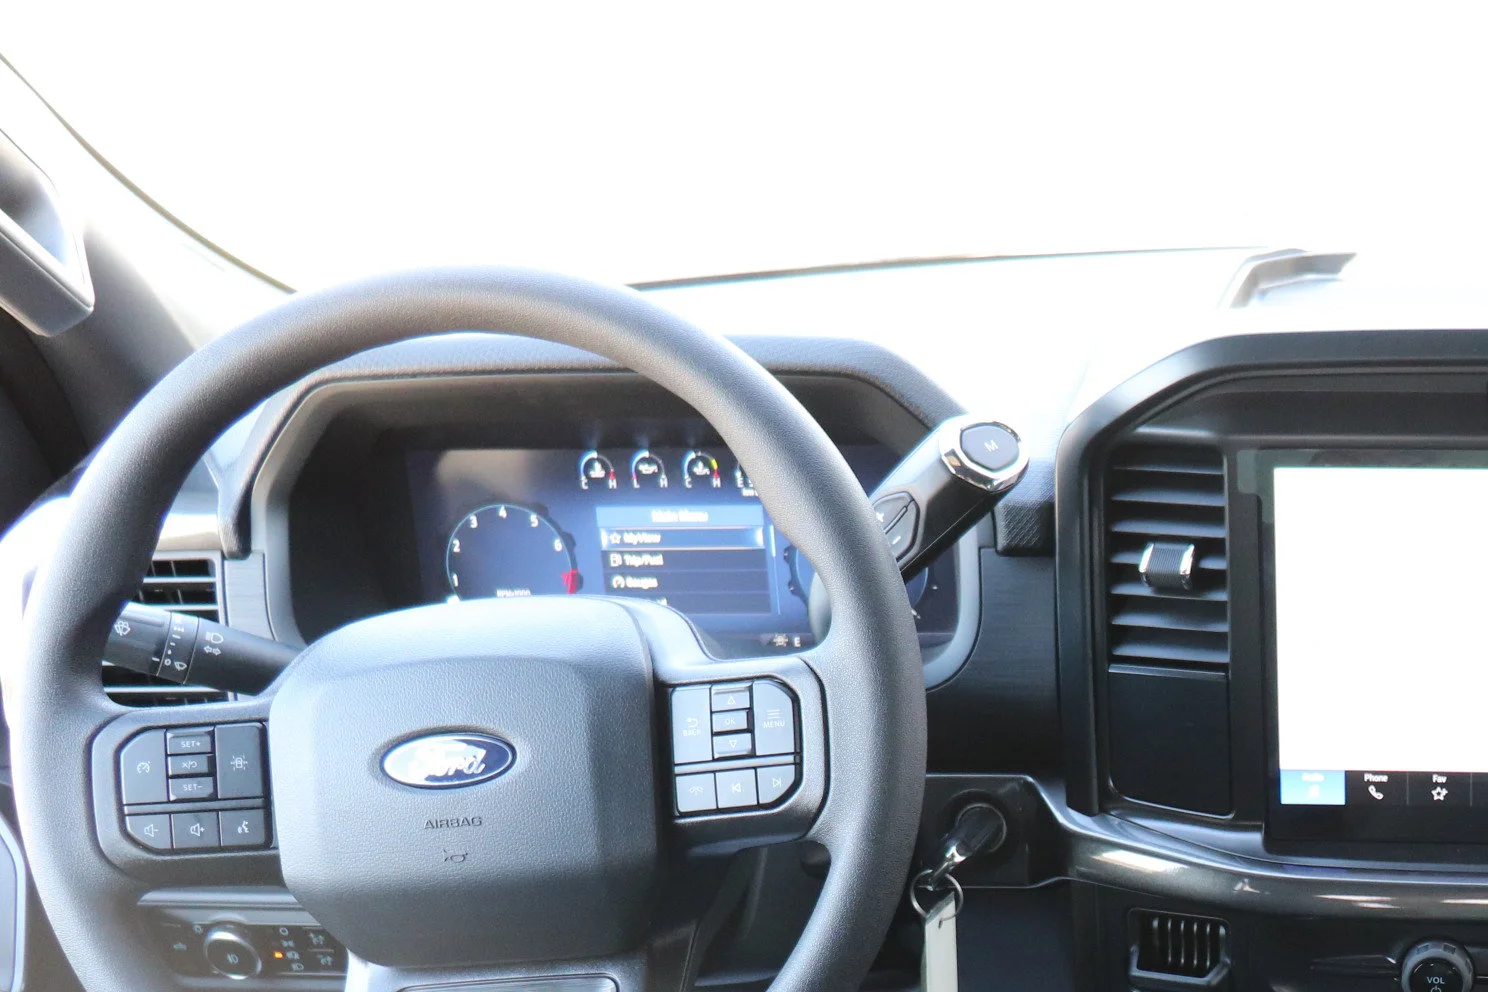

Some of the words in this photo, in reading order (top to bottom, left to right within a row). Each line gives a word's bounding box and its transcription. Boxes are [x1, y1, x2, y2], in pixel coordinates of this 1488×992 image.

[984, 440, 998, 452] M
[608, 478, 617, 489] H
[712, 477, 721, 488] H
[499, 505, 507, 518] 4
[470, 515, 478, 528] 3
[530, 514, 538, 527] 5
[452, 539, 460, 552] 2
[554, 538, 562, 551] 6
[453, 573, 459, 587] 1
[725, 718, 736, 726] OK
[763, 720, 785, 729] MENU
[1363, 773, 1388, 783] Phone
[1432, 774, 1447, 784] Fav
[424, 816, 482, 830] AIRBAG
[1427, 976, 1445, 985] VOL
